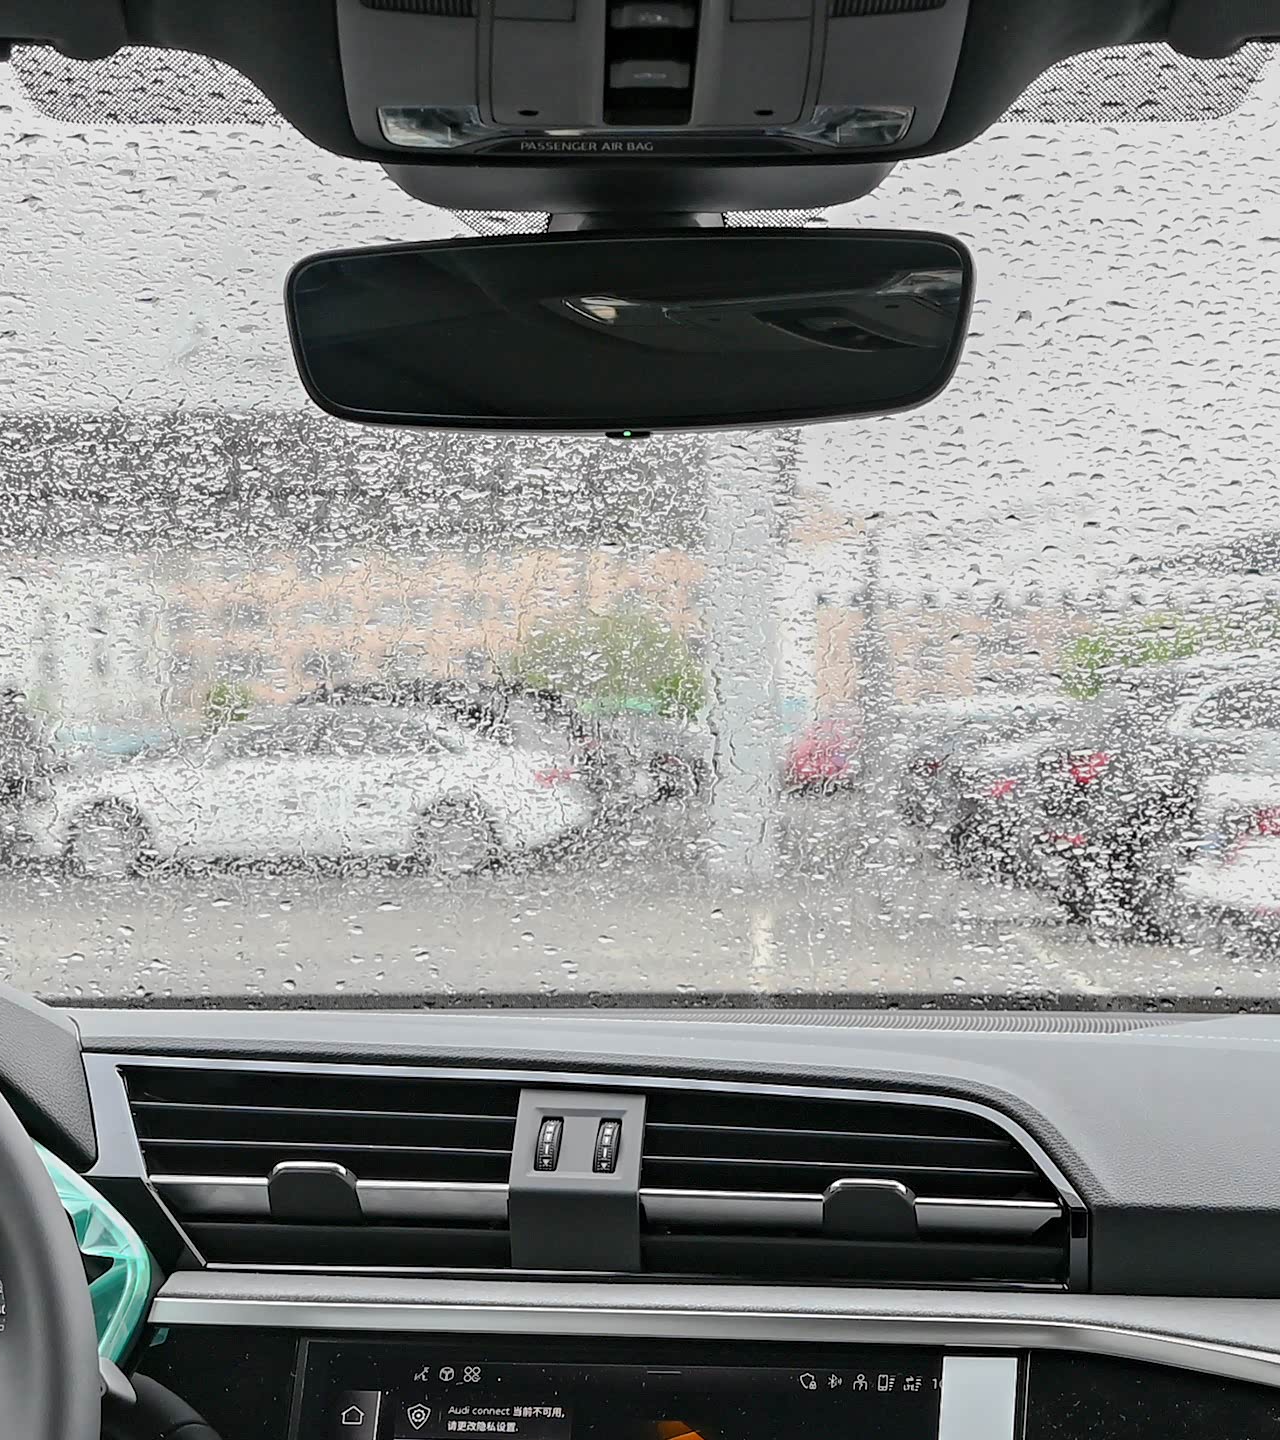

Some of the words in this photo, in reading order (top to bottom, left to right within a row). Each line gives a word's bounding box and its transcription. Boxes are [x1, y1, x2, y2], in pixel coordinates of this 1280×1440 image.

[520, 141, 597, 151] PASSENGER
[601, 141, 624, 151] AIR
[626, 141, 654, 151] BAG
[448, 1405, 470, 1415] Audi
[471, 1407, 511, 1416] connect
